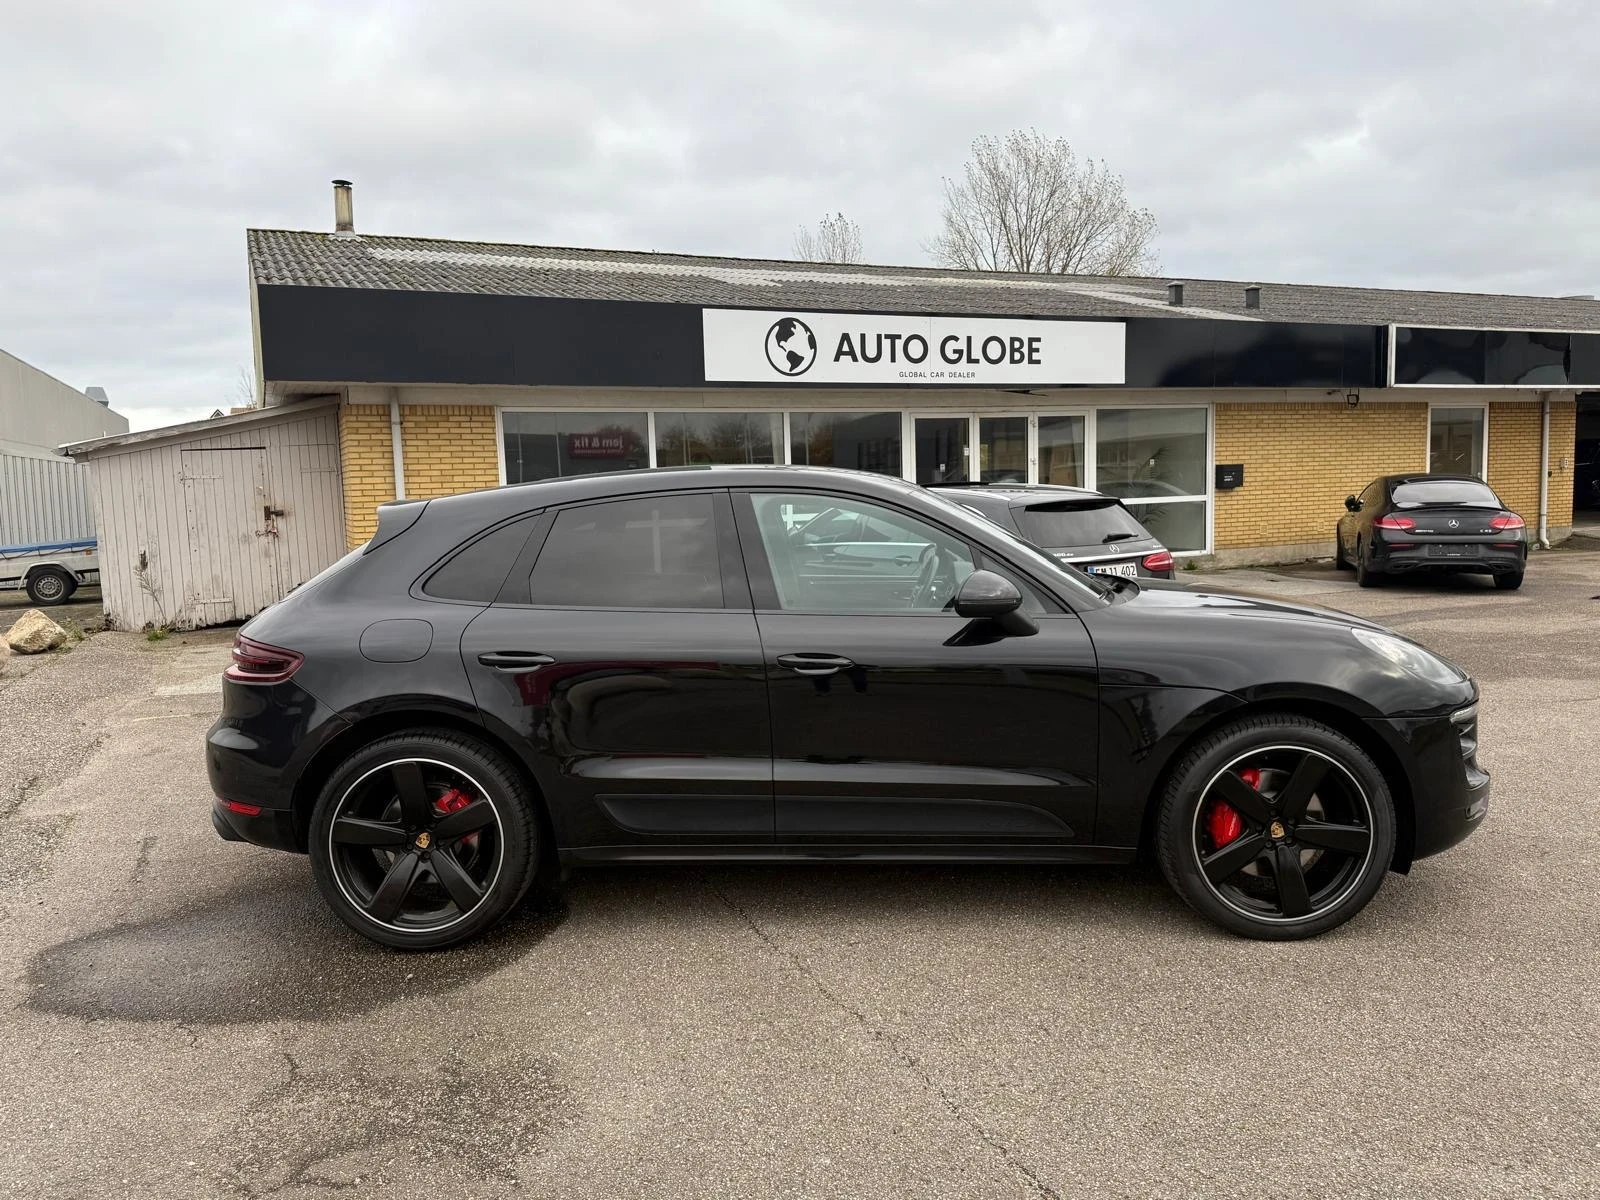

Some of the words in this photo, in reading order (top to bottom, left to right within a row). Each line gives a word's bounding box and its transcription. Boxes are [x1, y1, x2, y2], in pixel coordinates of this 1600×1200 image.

[833, 332, 929, 365] AUTO
[939, 334, 1042, 365] GLOBE
[948, 371, 976, 379] DEALER
[1121, 565, 1136, 577] 402
